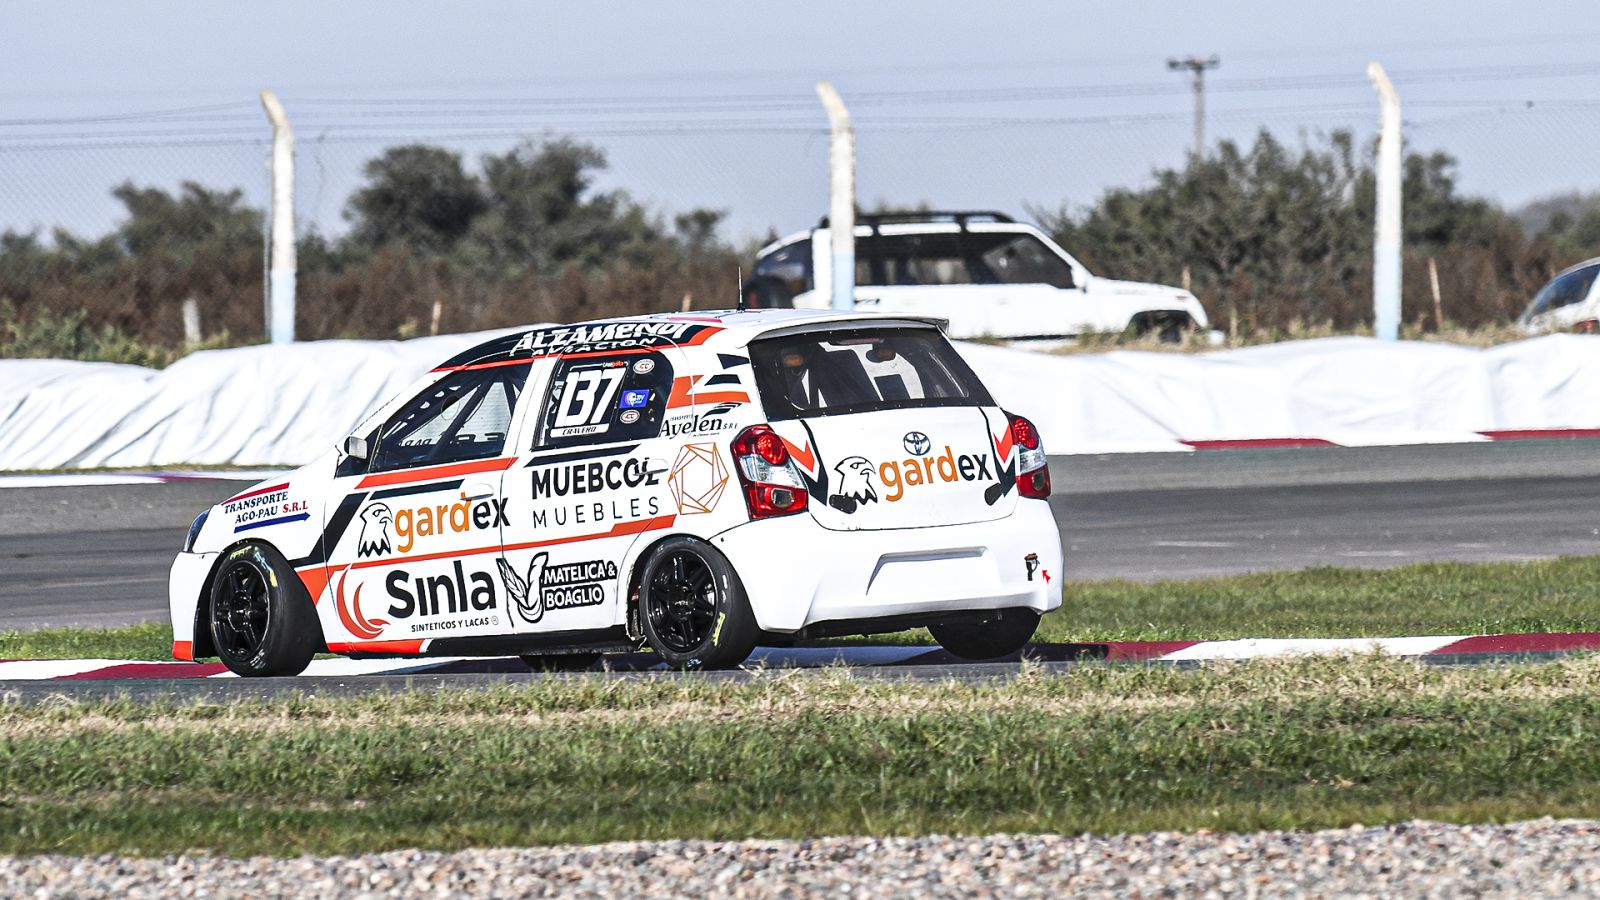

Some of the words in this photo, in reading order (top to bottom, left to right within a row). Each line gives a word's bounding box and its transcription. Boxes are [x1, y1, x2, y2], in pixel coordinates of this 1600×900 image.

[555, 367, 627, 428] 137
[660, 415, 722, 440] Ayelen
[531, 458, 659, 500] MUEBCOL
[879, 446, 993, 502] gardex
[224, 491, 289, 514] TRANSPORTE
[235, 506, 278, 524] AGO-PAU
[533, 497, 659, 529] MUEBLES
[395, 492, 511, 553] gardex
[543, 561, 605, 585] MATELICA
[607, 562, 616, 577] &
[546, 588, 603, 609] BOAGLIO
[411, 620, 457, 633] SINTETICOS
[458, 620, 463, 628] Y
[465, 617, 490, 628] LACAS
